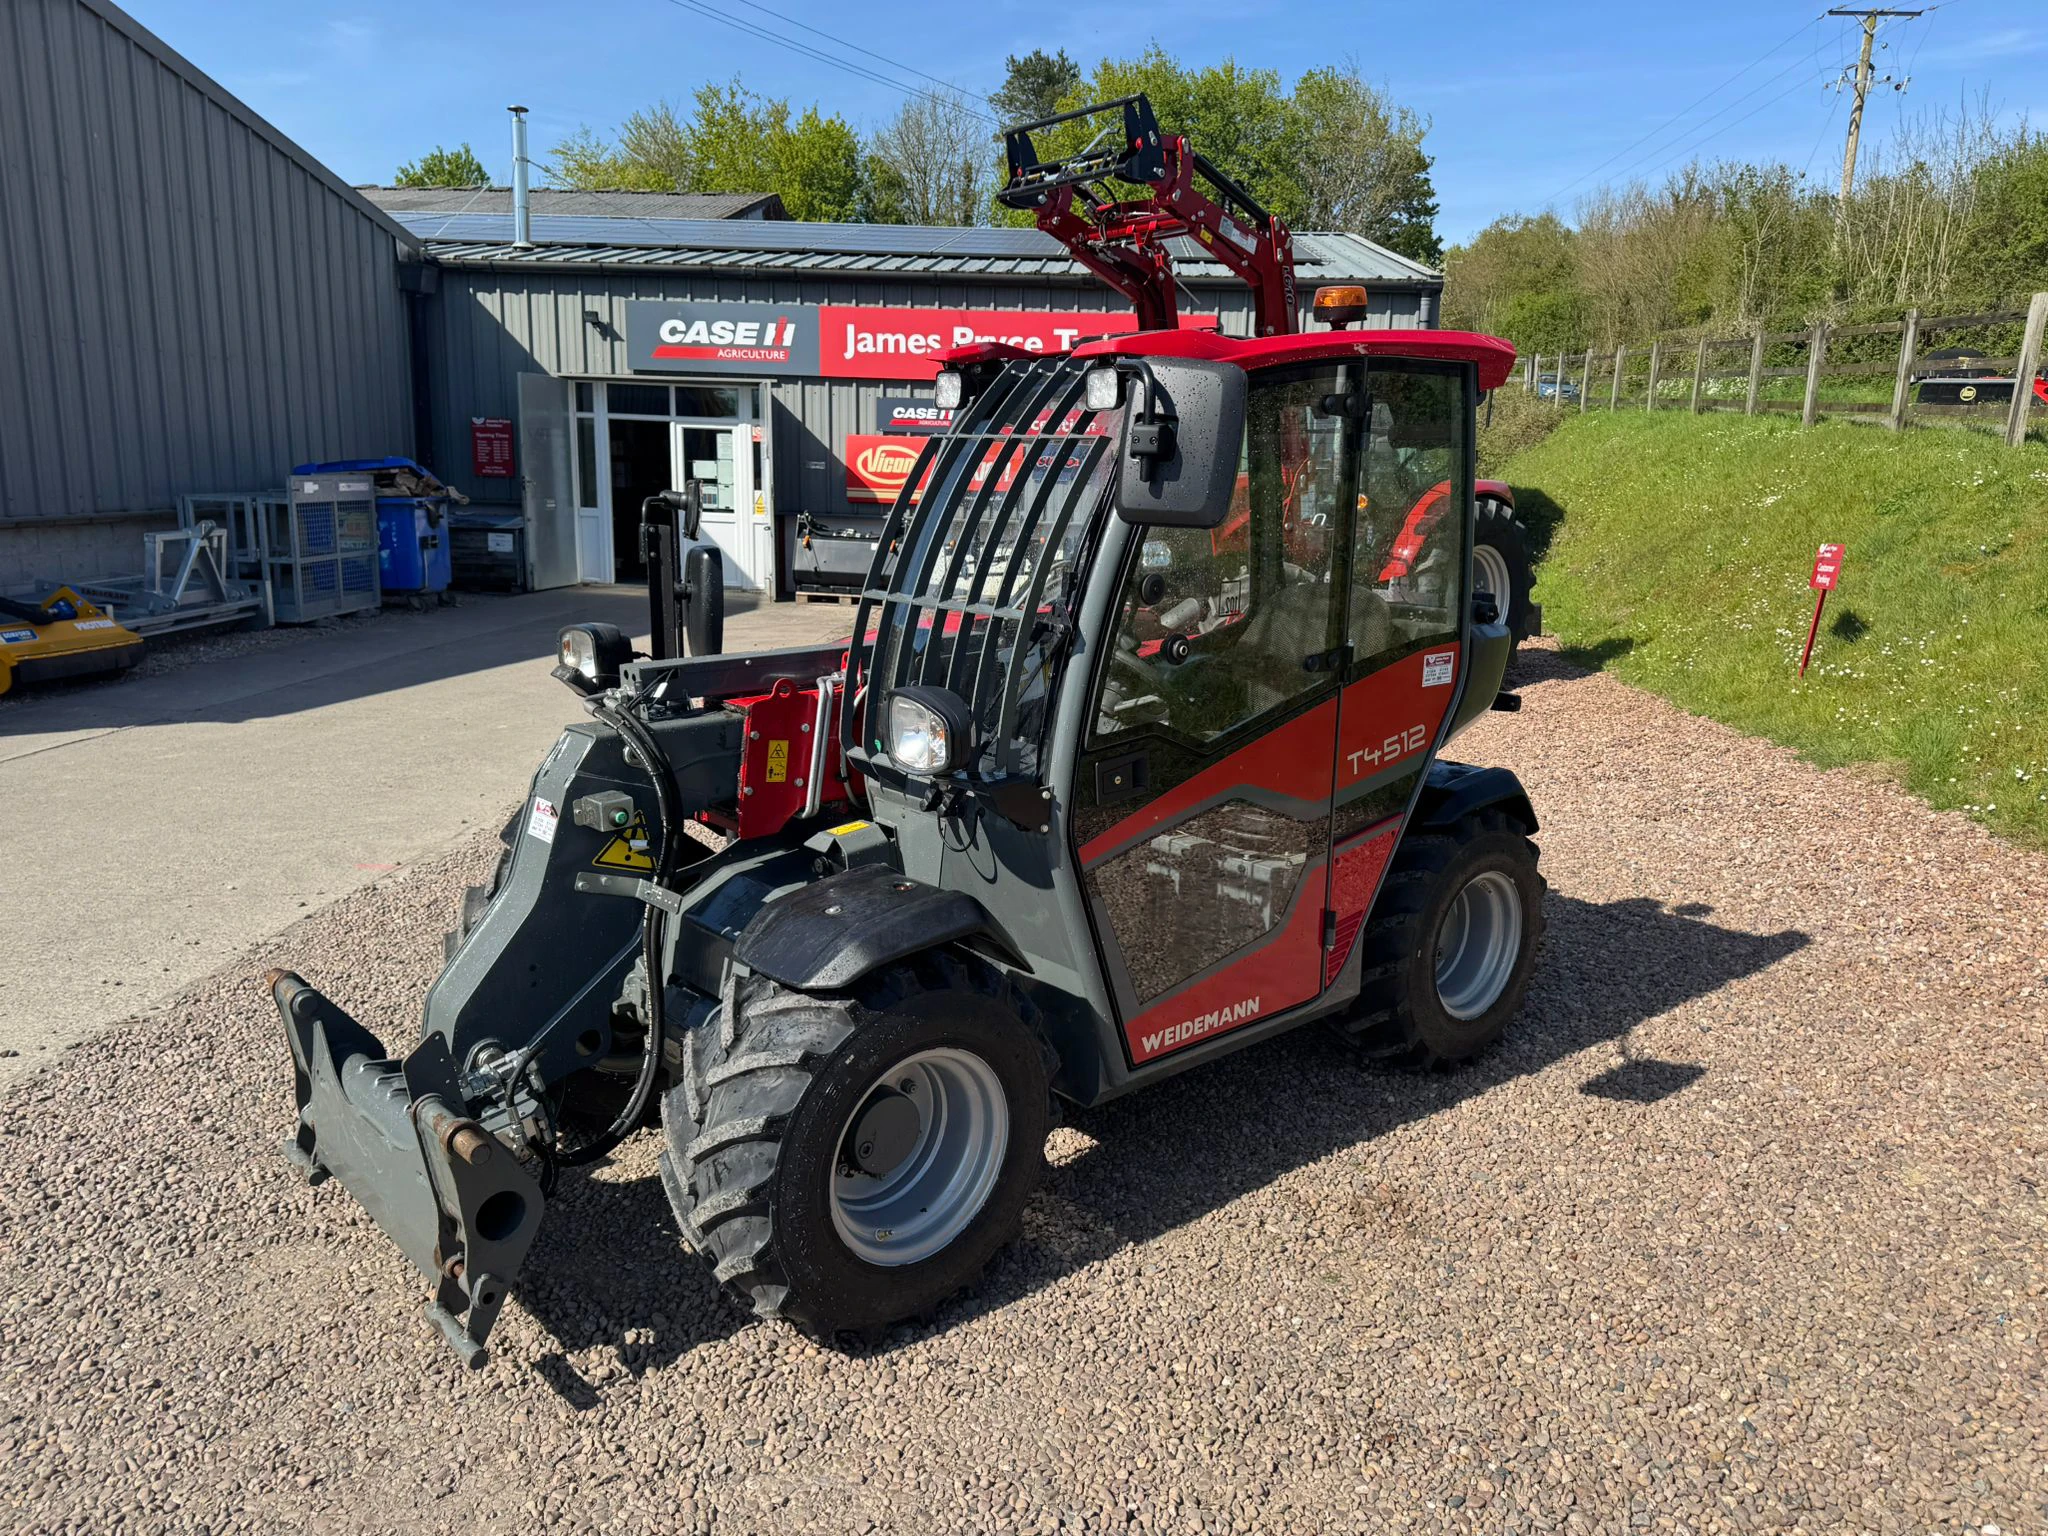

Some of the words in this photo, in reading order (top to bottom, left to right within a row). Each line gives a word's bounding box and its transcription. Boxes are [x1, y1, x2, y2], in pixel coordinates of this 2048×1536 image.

[659, 319, 760, 344] CASE
[844, 323, 941, 360] James
[717, 349, 786, 360] AGRICULTURE
[892, 406, 938, 419] CASE
[867, 447, 917, 473] Vicon
[1346, 723, 1426, 776] T4512
[1141, 996, 1260, 1053] WEIDEMANN
